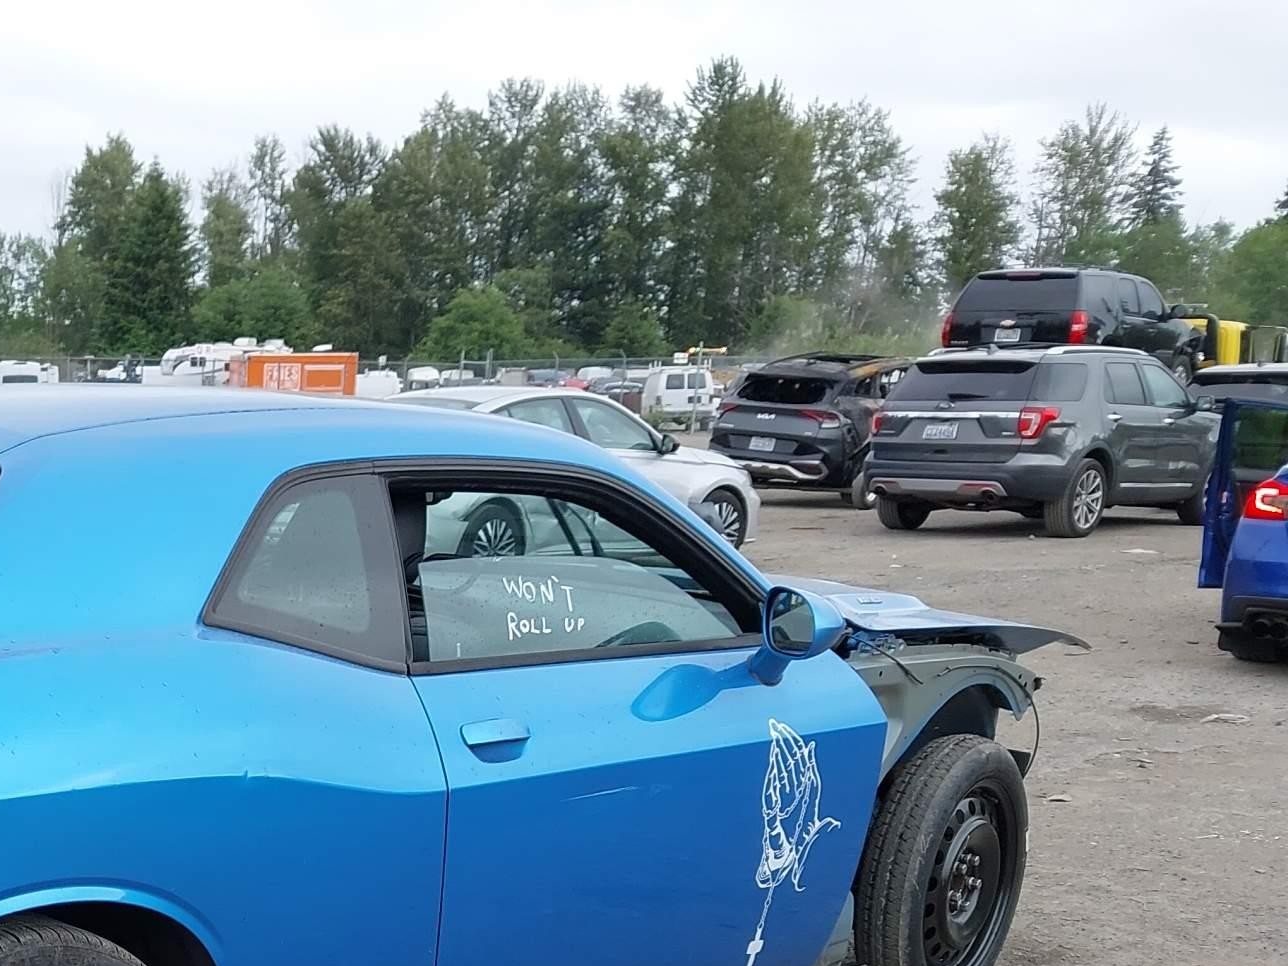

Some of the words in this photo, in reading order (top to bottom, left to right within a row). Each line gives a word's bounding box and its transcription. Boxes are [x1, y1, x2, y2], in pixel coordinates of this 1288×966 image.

[502, 575, 574, 612] WON'T
[507, 611, 552, 641] ROLL
[564, 617, 585, 633] UP
